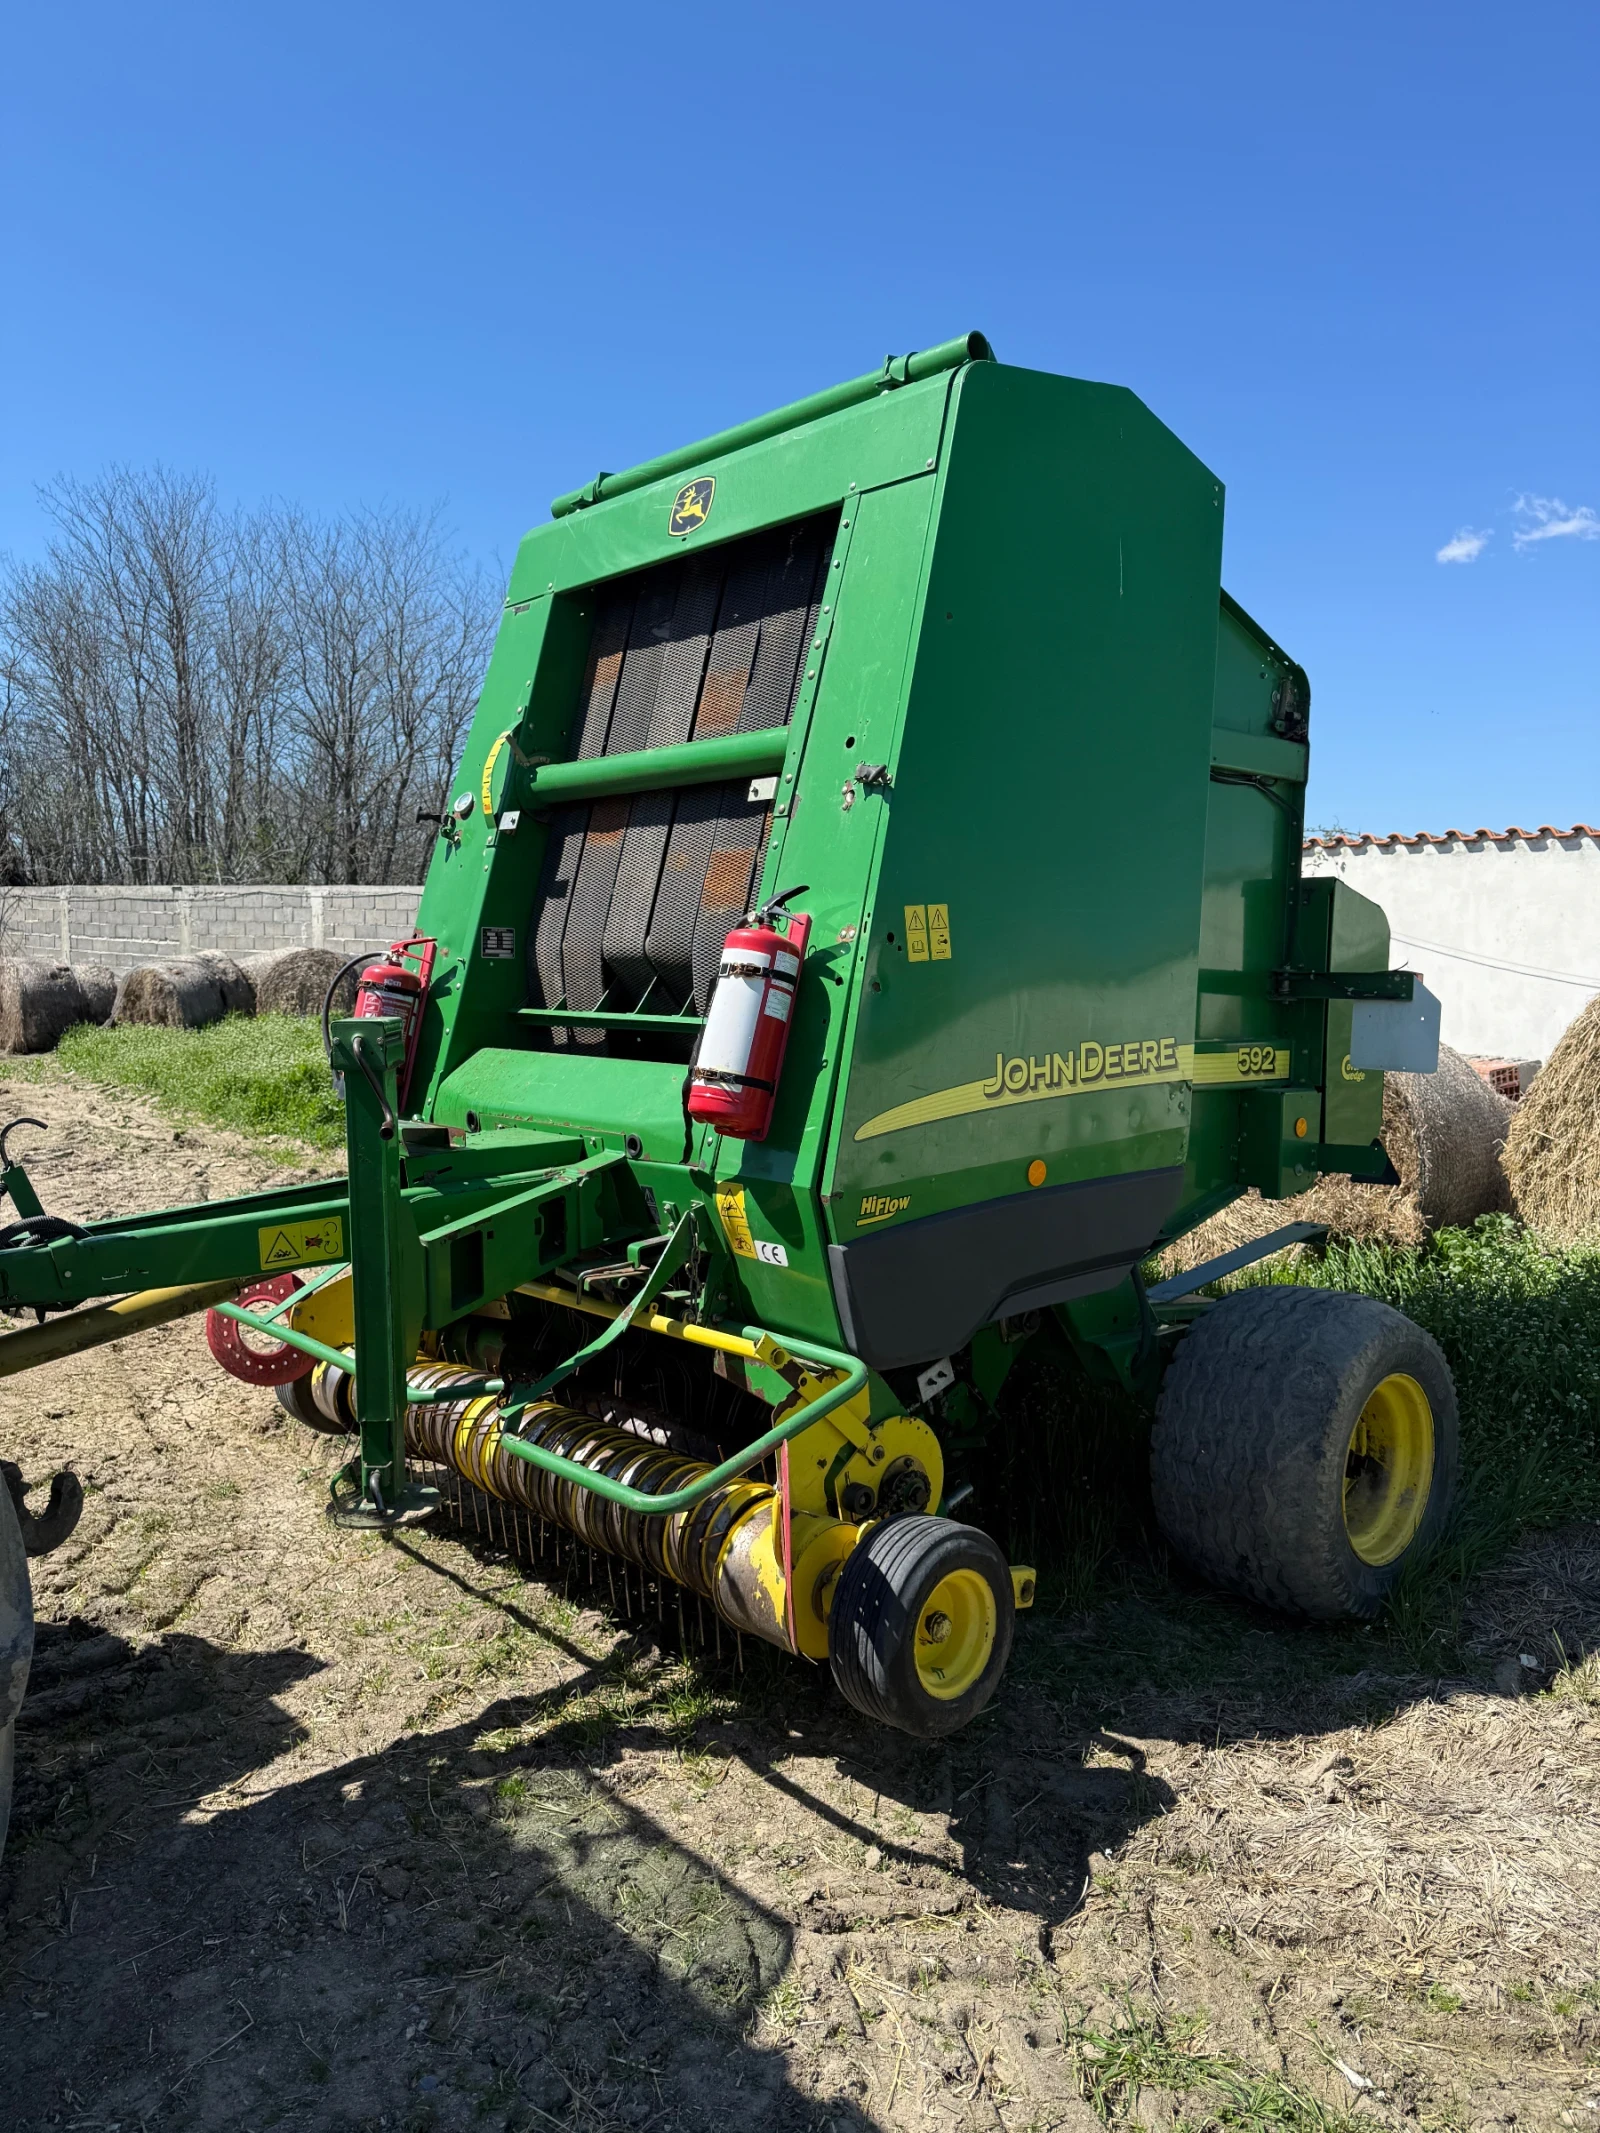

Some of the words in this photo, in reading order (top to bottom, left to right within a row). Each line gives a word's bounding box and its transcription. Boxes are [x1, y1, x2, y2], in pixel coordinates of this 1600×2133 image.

[983, 1050, 1077, 1098] JOHN
[1079, 1037, 1177, 1081] DEERE
[1237, 1046, 1276, 1074] 592
[860, 1195, 912, 1216] HiFlow
[761, 1243, 782, 1264] CE
